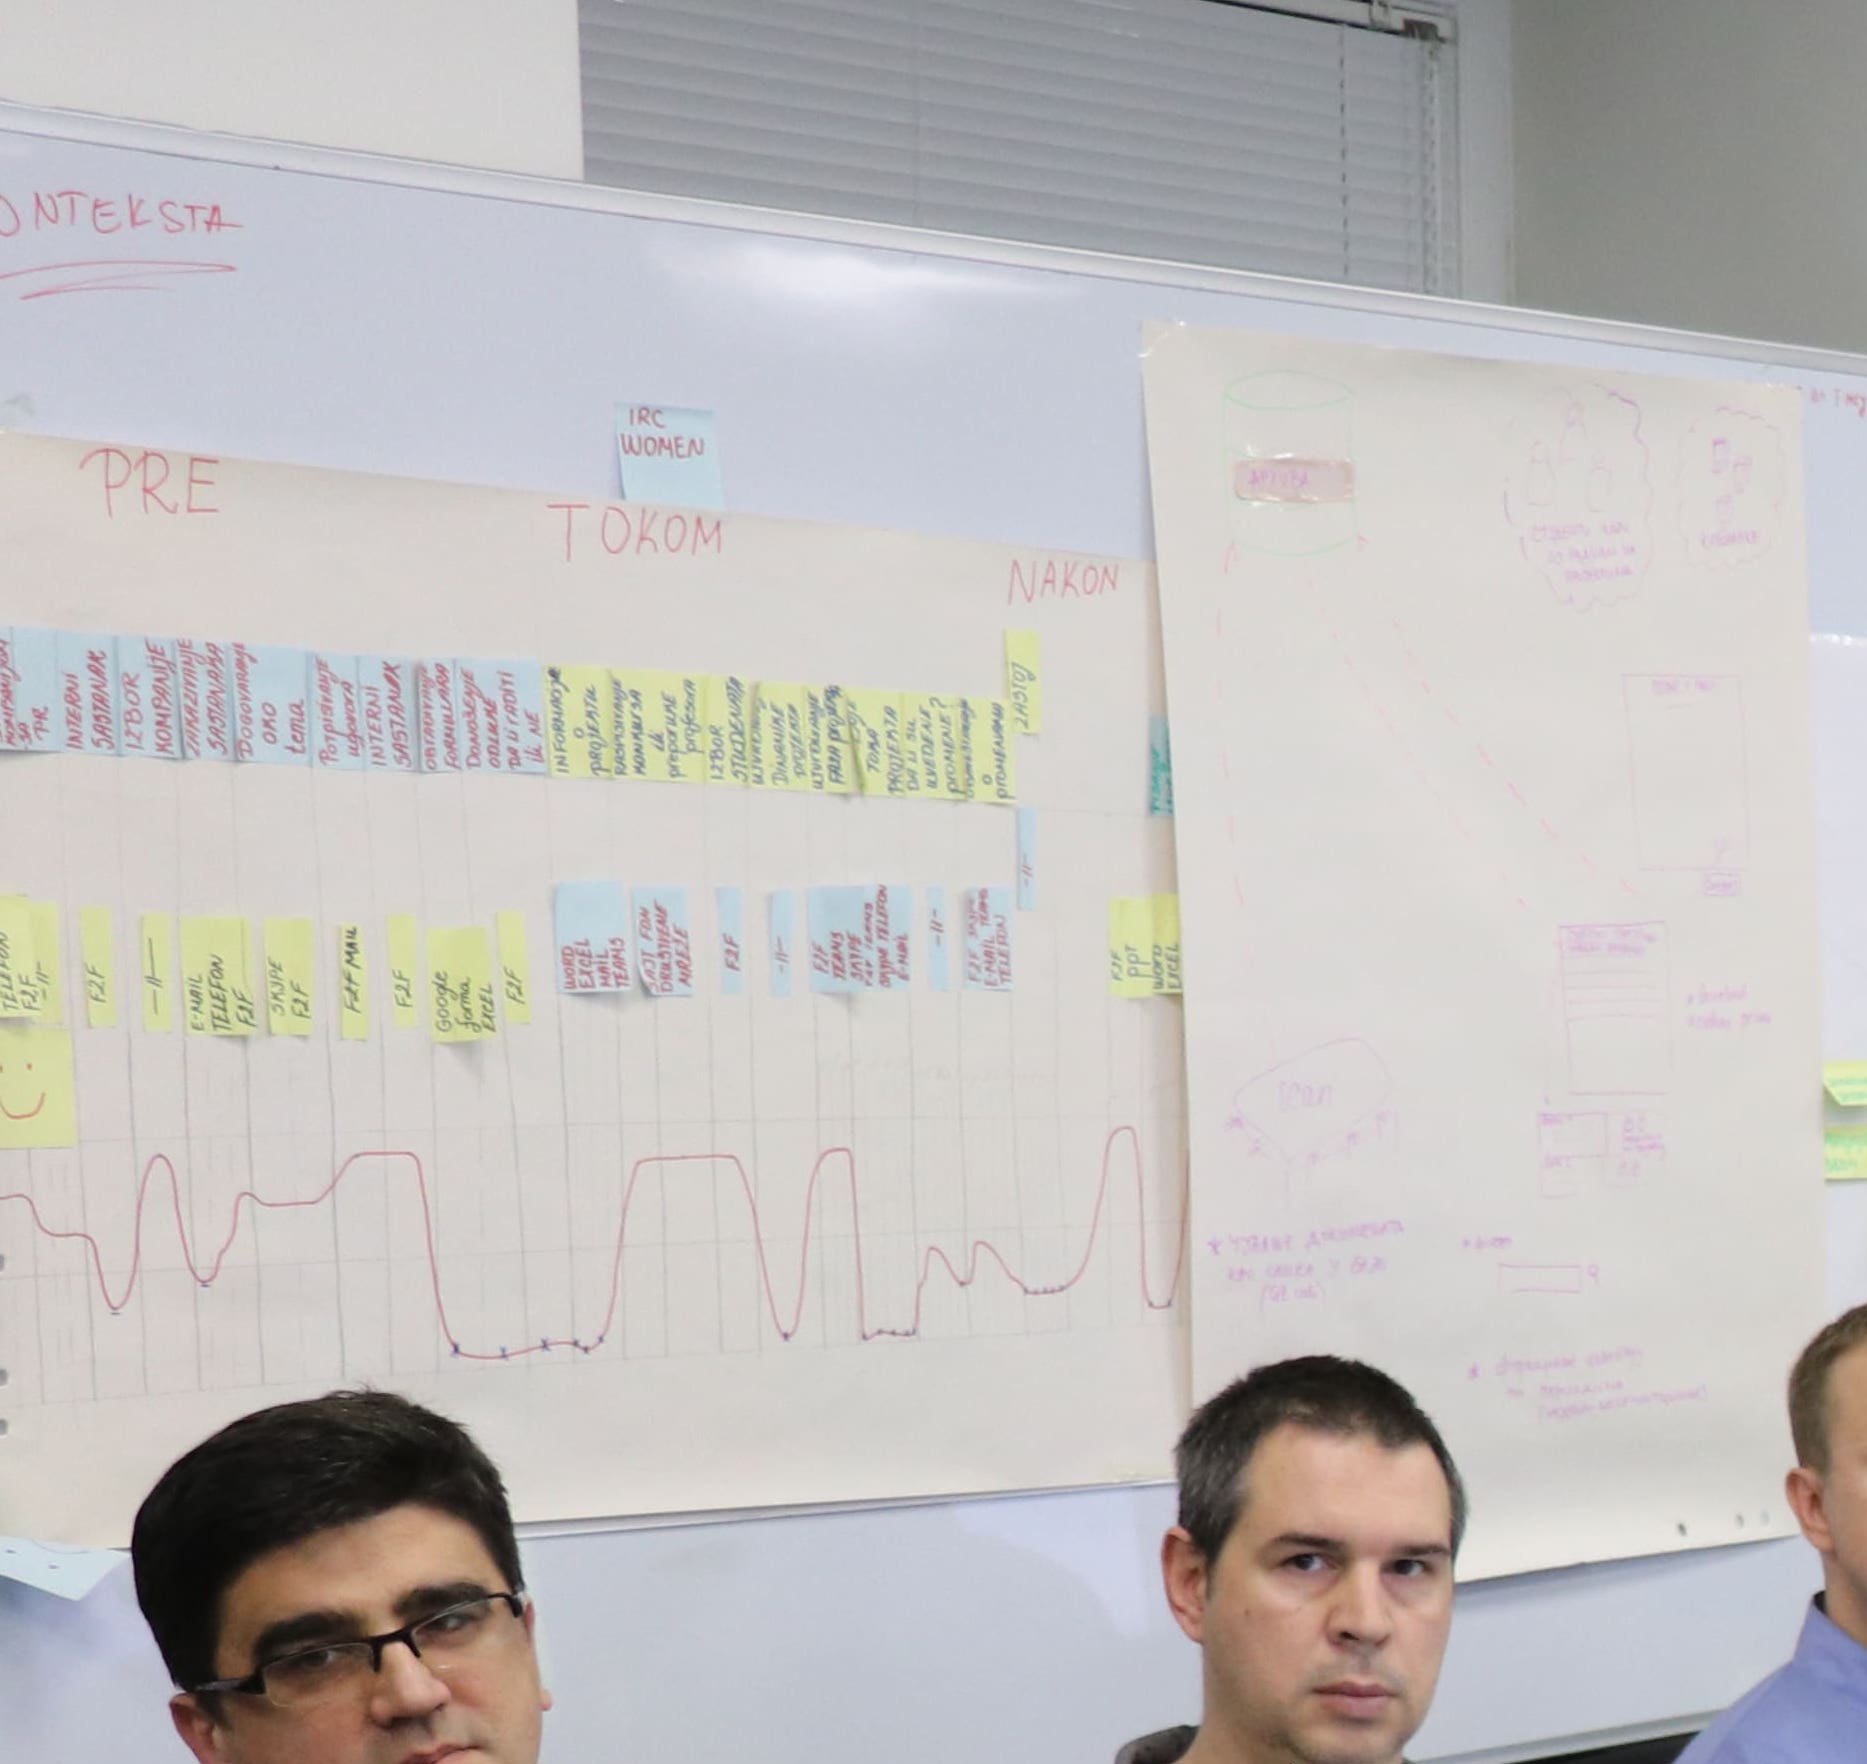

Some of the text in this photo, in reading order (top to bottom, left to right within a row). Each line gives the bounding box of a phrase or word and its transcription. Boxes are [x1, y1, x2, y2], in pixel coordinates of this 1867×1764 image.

[628, 405, 667, 430] IRC
[619, 431, 707, 461] WOMEN
[80, 446, 221, 519] PRE
[547, 501, 725, 564] TOKOM
[1008, 559, 1119, 606] NAKON
[63, 672, 83, 749] INTERNI
[86, 650, 115, 749] SASTANAK
[122, 672, 144, 749] IZBOR
[144, 637, 176, 755] KOMPANIJE
[261, 702, 277, 744] OKO
[365, 686, 387, 766] INTERNI
[561, 945, 577, 990] WORD
[574, 938, 596, 989] EXCEL
[593, 948, 613, 987] MAIL
[608, 937, 630, 988] TEAMS
[722, 932, 741, 972] F2F
[84, 961, 106, 1004] F2F
[207, 953, 234, 1032] TELEFON
[392, 968, 414, 1008] F2F
[503, 965, 526, 1005] F2F
